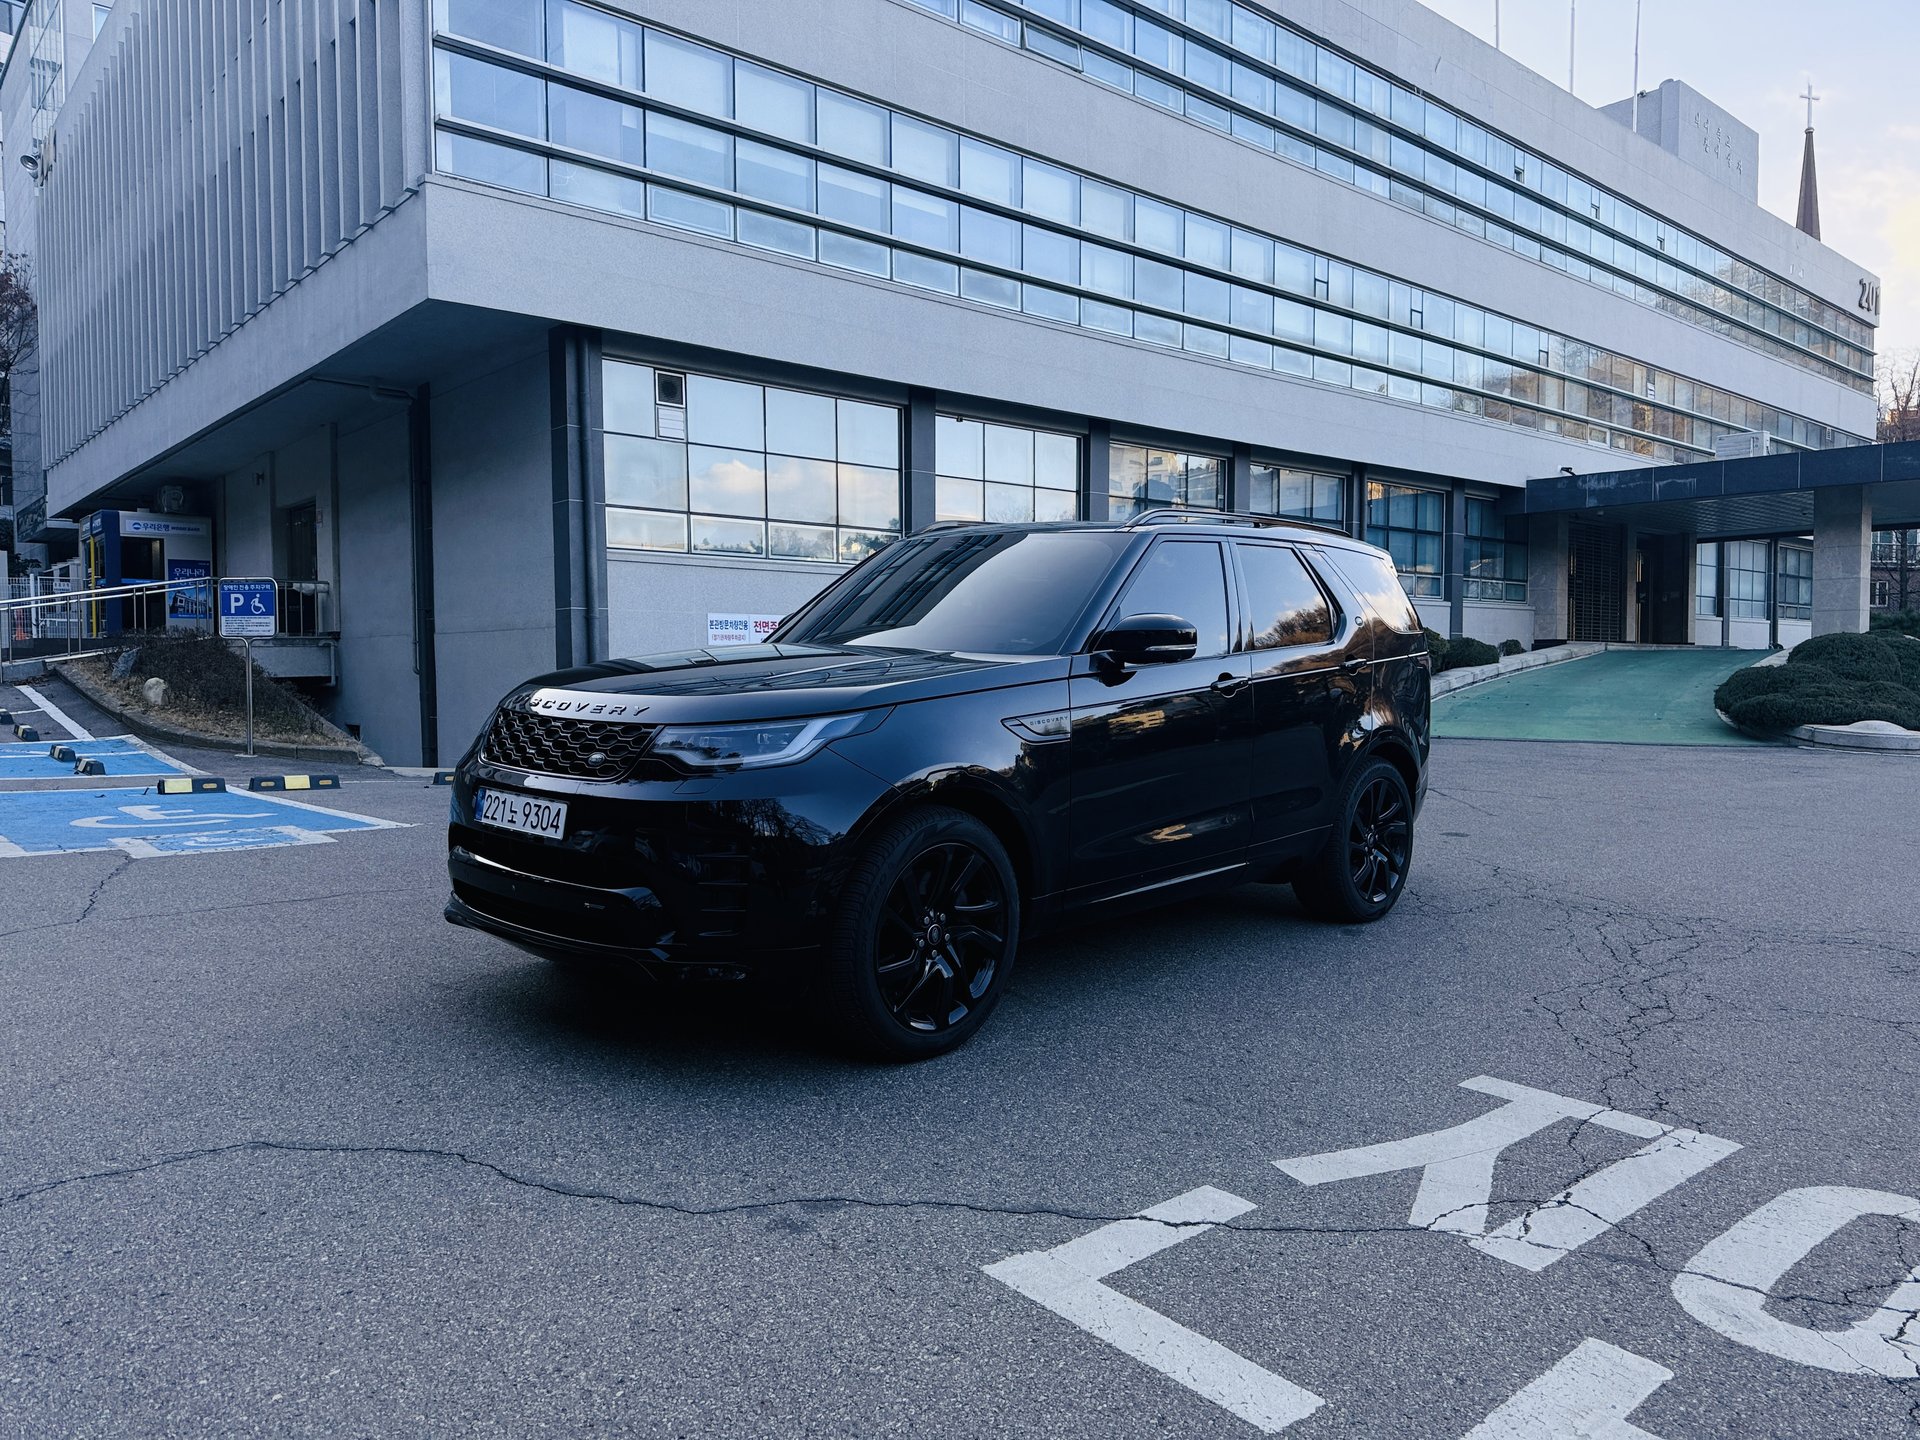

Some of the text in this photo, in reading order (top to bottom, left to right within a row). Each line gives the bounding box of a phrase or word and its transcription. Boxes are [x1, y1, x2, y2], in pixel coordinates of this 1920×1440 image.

[142, 522, 170, 532] 우리은행
[173, 567, 205, 577] 우리나라
[230, 593, 245, 614] P
[710, 620, 749, 631] 본관방문차량전용
[753, 620, 778, 634] 전면주
[1029, 715, 1069, 726] DISCOVERY
[483, 793, 562, 834] 221노 9304
